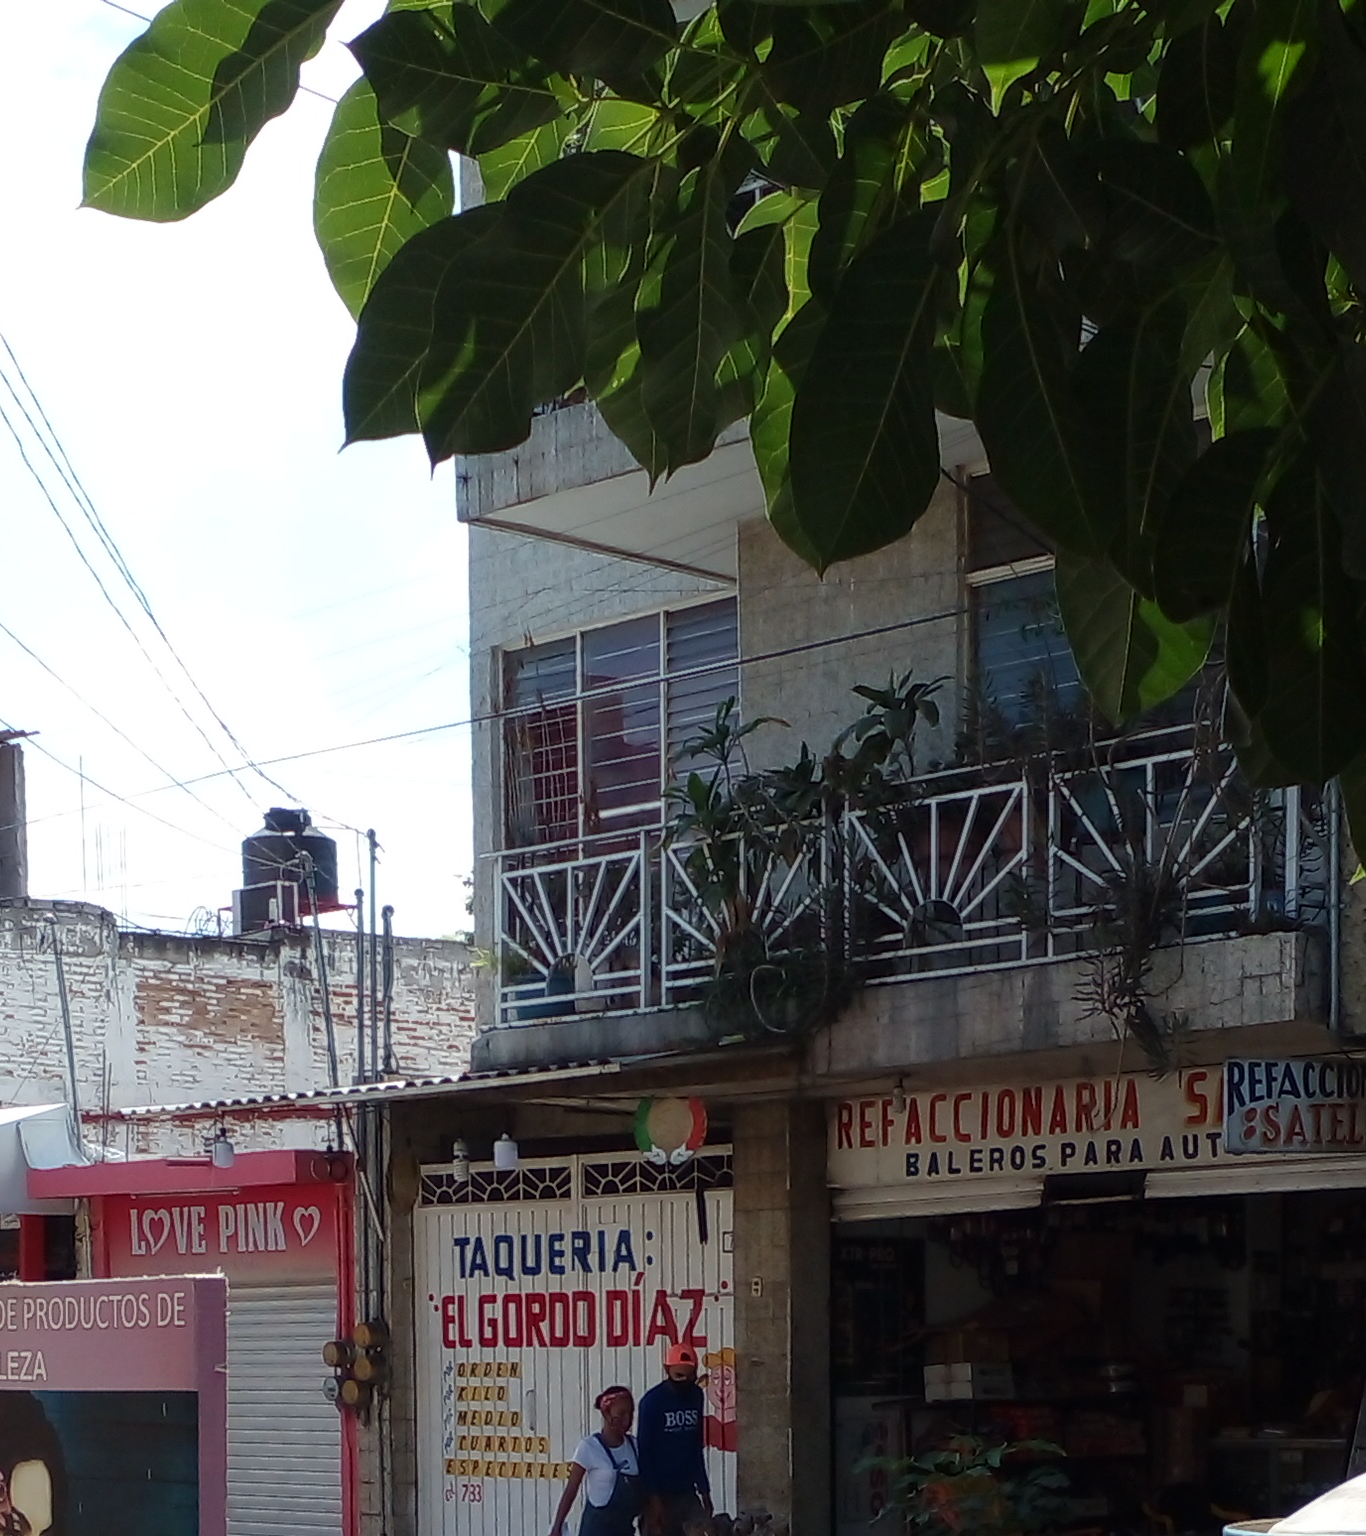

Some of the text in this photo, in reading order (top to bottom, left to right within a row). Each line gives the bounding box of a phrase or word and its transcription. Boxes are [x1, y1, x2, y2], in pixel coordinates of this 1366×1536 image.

[837, 1078, 1140, 1150] REFACCIONARIA
[905, 1143, 1047, 1177] BALEROS
[1061, 1137, 1143, 1168] PARA
[217, 1202, 287, 1254] PINK
[23, 1293, 151, 1330] PRODUCTOS
[157, 1292, 186, 1327] DE
[441, 1272, 708, 1348] EL GORDO DÍAZ
[457, 1362, 519, 1377] ORDEN
[457, 1386, 505, 1401] KILO
[457, 1410, 519, 1426] MEDIO
[664, 1410, 699, 1428] BOSS
[459, 1436, 546, 1453] CUARTOS
[446, 1459, 573, 1478] ESPECIALES
